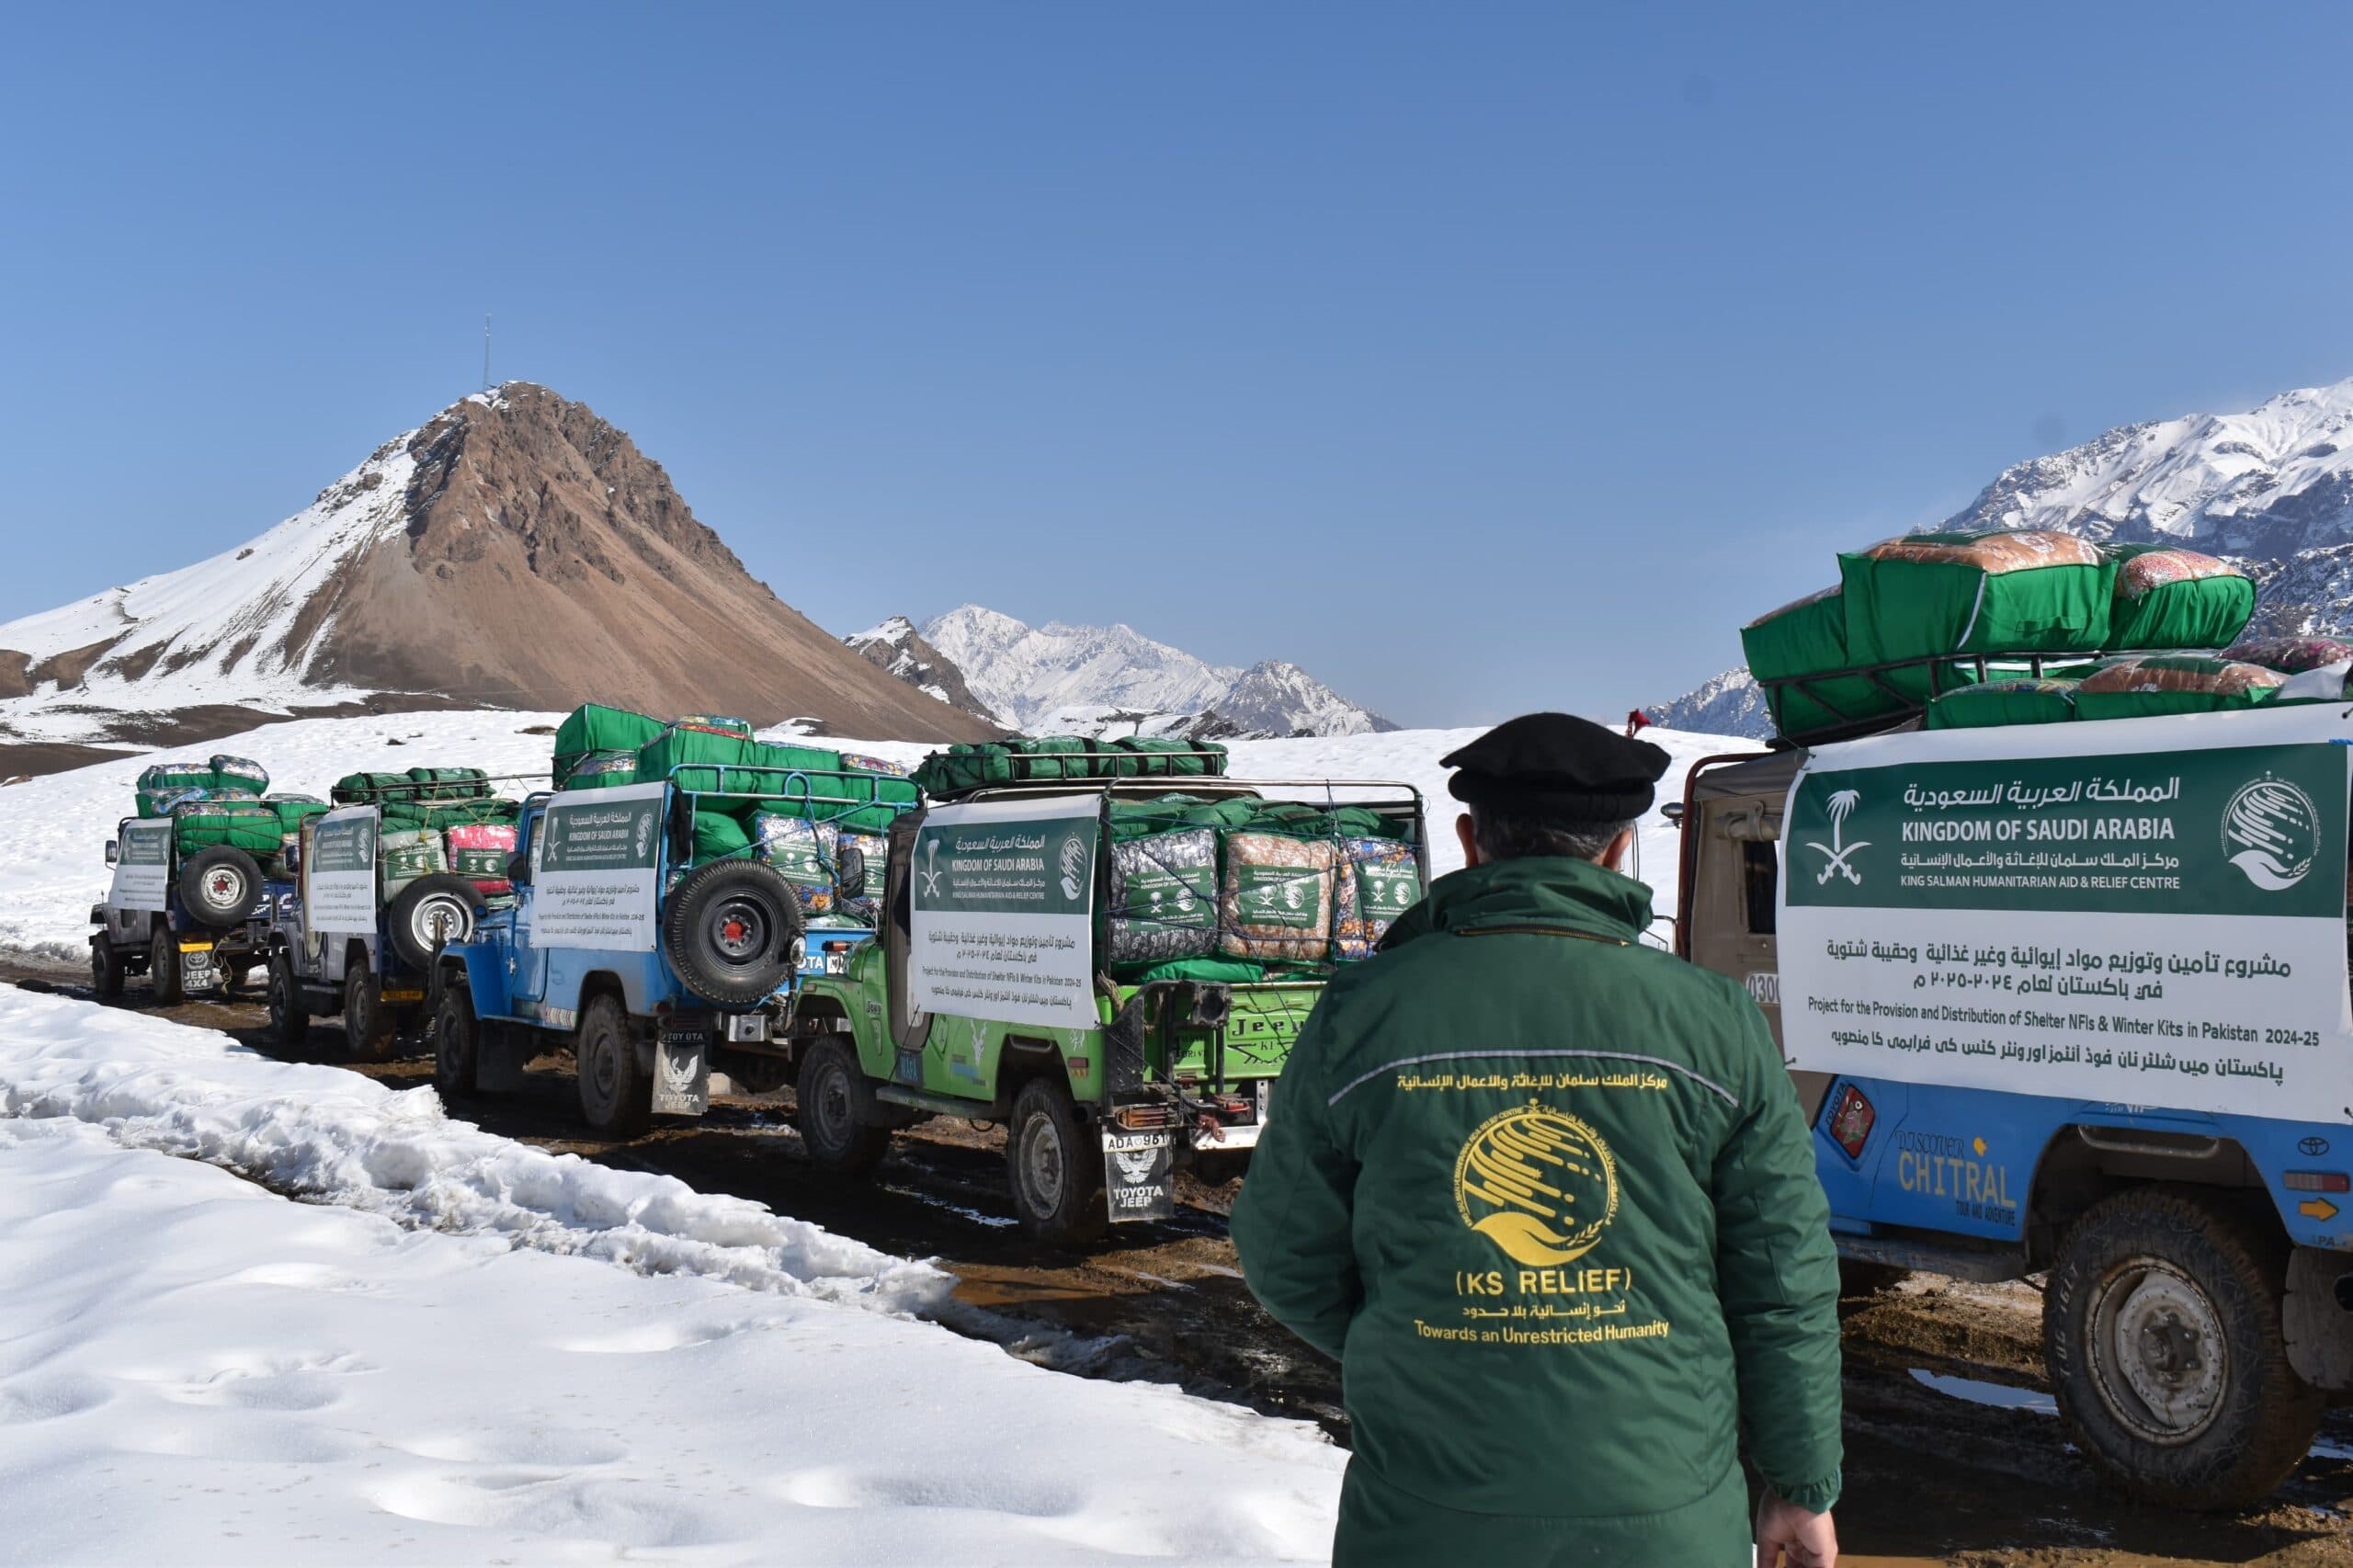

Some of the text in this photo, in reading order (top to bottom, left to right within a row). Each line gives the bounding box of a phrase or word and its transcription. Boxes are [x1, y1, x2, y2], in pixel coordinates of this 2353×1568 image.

[1904, 777, 2179, 812] المملكة العربية السعودية
[1902, 817, 2175, 842] KINGDOM OF SAUDI ARABIA
[956, 834, 1045, 853] المملكة العربية السعودية
[952, 858, 1044, 871] KINGDOM OF SAUDI ARABIA
[1901, 851, 2179, 869] مركز الملك سلمان للإغاثة والأعمال الإنسانية
[1901, 875, 2180, 889] KING SALMAN HUMANITARIAN AID & RELIEF CENTRE
[1827, 939, 2290, 979] مشروع تأمين وتوزيع مواد إيوائية وغير غذائية وحقيبة شتوية
[185, 971, 210, 980] JEEP
[1914, 972, 1926, 988] م
[2017, 974, 2052, 994] لعام
[2057, 976, 2129, 1000] باكستان
[2134, 981, 2162, 1000] في
[1809, 996, 2320, 1046] Project for the Provision and Distribution of Shelter NFIs & Winter Kits in Pakistan 2024-25
[2026, 1045, 2045, 1062] اور
[2118, 1051, 2138, 1068] نان
[1556, 1074, 1598, 1088] سلمان
[1601, 1074, 1638, 1088] الملك
[1639, 1074, 1667, 1088] مركز
[1108, 1137, 1133, 1150] ADA
[1898, 1152, 2017, 1209] CHITRAL
[1113, 1186, 1164, 1199] TOYOTA
[1120, 1196, 1153, 1208] JEEP
[1519, 1267, 1631, 1294] RELIEF)
[1462, 1308, 1508, 1319] حدود
[1511, 1305, 1526, 1320] بلا
[1415, 1320, 1668, 1344] Towards an Unrestricted Humanity
